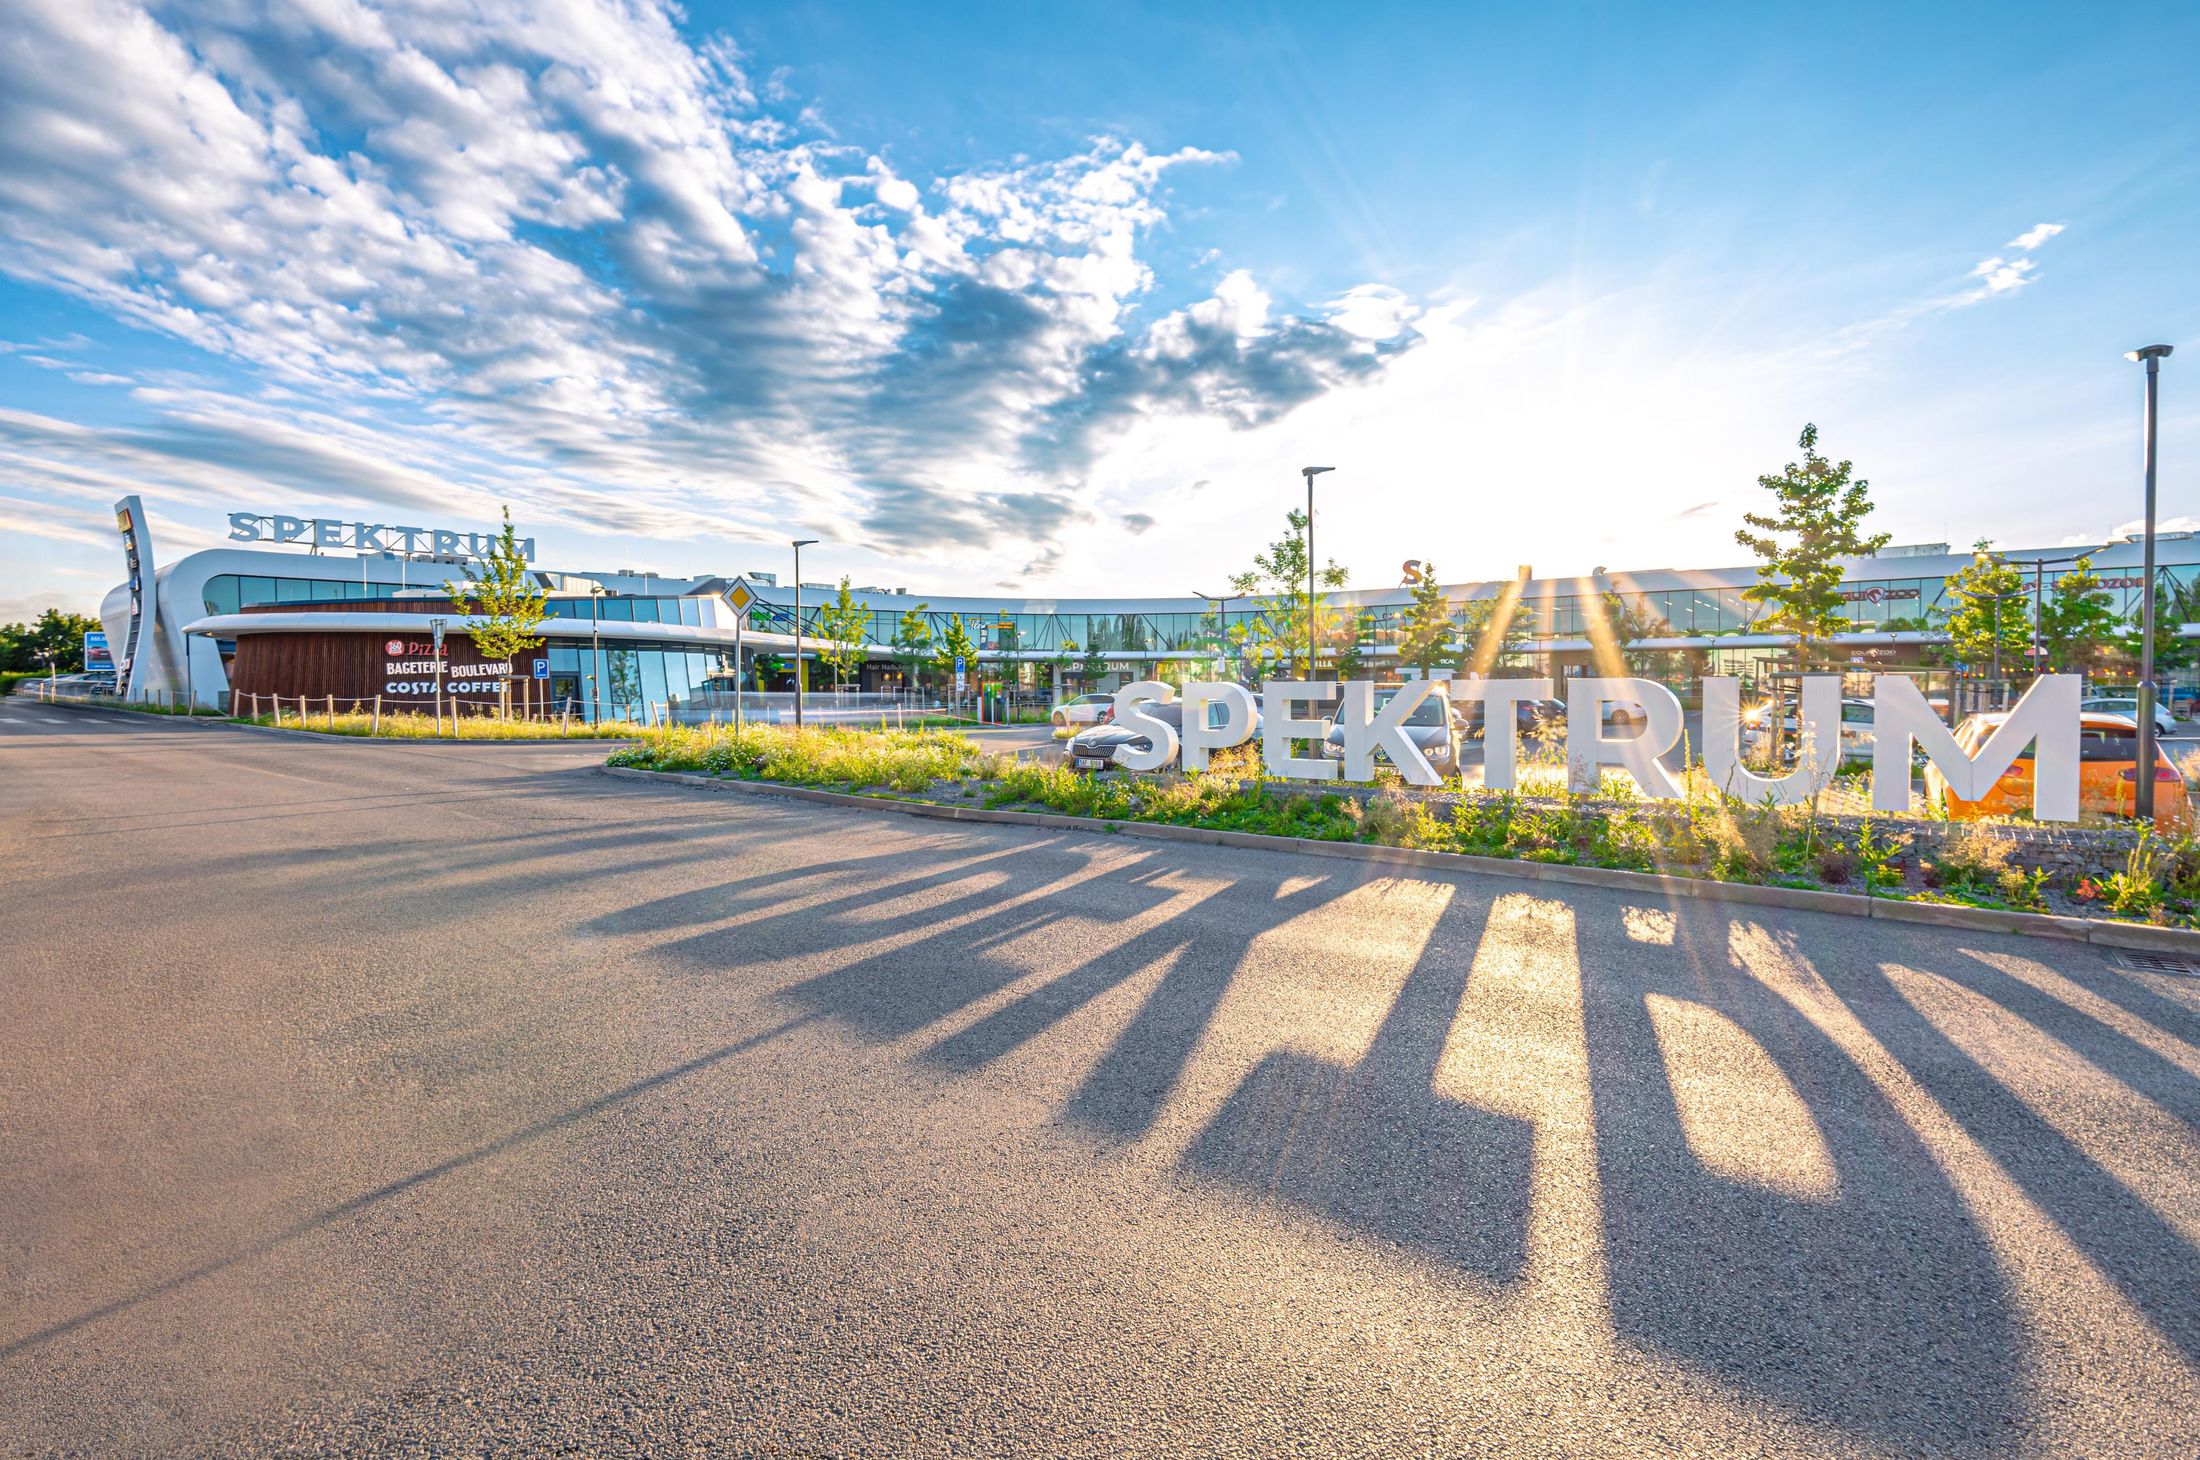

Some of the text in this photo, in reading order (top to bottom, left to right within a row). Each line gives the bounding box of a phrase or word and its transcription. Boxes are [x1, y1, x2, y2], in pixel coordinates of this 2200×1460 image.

[228, 512, 535, 563] SPEKTRUM
[386, 661, 448, 675] BAGETERE
[537, 662, 546, 673] P
[866, 663, 880, 671] Hair
[957, 658, 963, 668] P
[1113, 674, 2082, 822] SPEKTRUM
